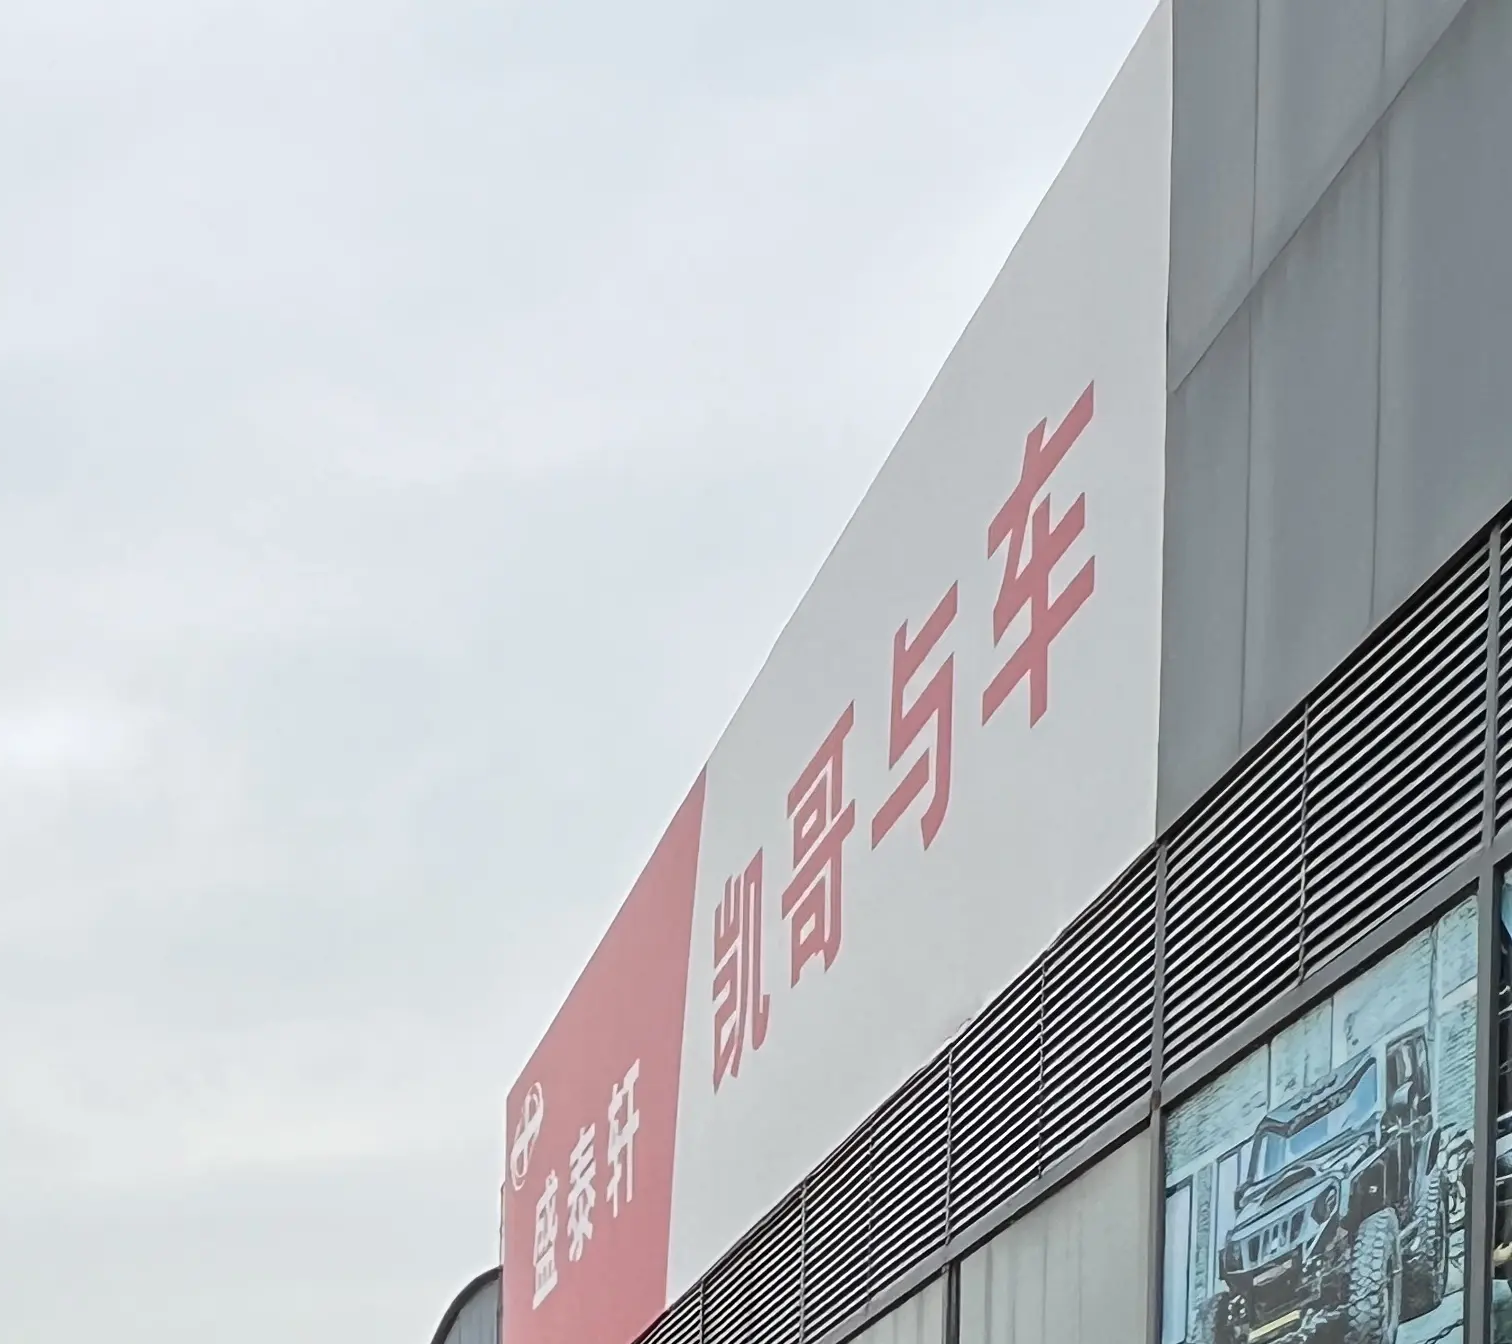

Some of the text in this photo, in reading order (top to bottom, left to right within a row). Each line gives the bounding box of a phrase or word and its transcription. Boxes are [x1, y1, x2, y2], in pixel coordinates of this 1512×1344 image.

[713, 379, 1095, 1094] 凯哥与车
[532, 1058, 641, 1311] 盛泰轩
